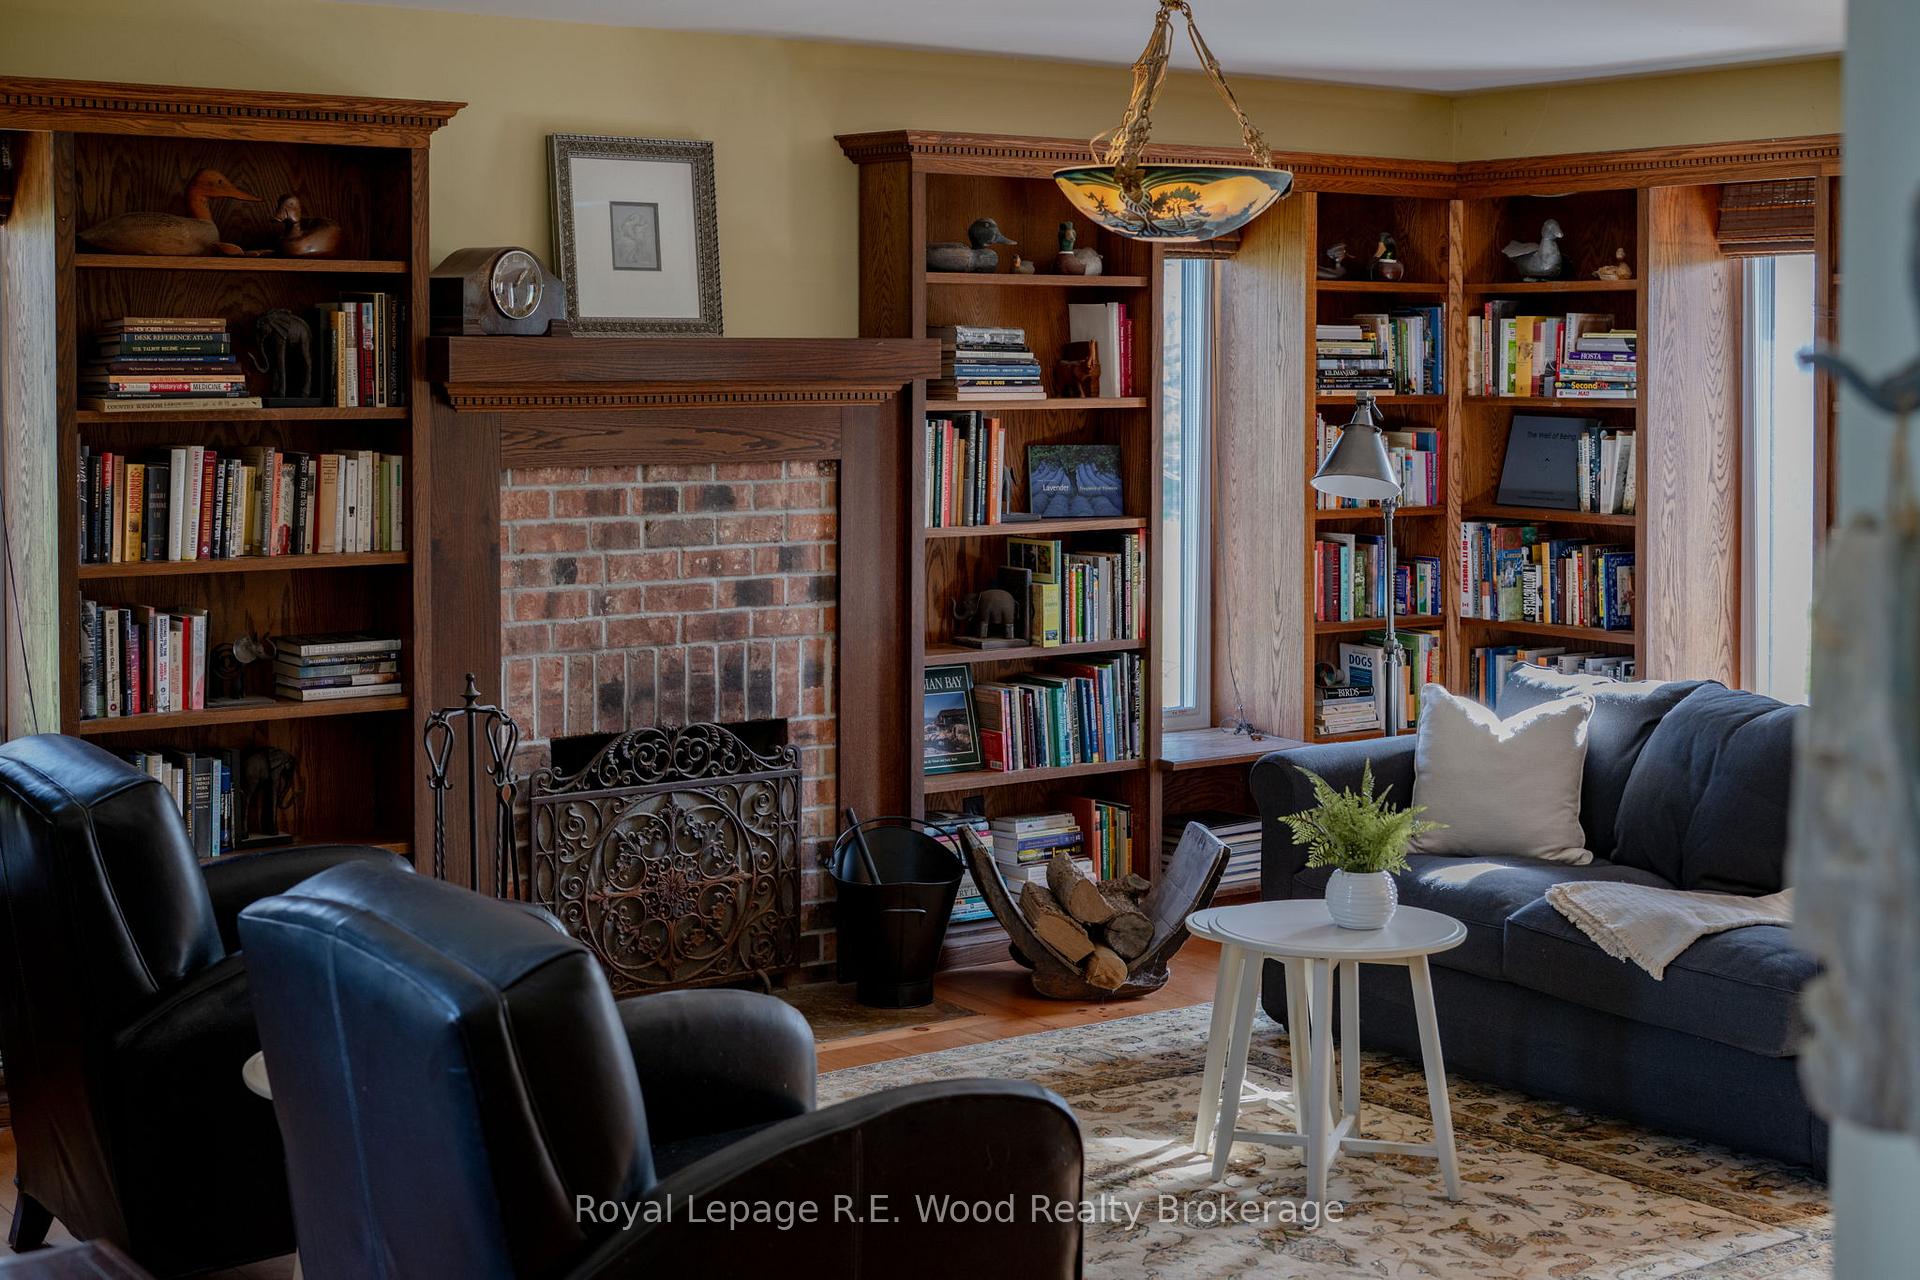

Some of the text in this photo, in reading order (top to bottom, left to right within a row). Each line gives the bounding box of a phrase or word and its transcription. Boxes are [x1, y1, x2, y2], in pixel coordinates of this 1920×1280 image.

[1580, 352, 1602, 360] HOSTA
[1571, 381, 1597, 390] Second
[130, 471, 142, 513] SHANTARAM
[1042, 484, 1069, 492] Lavender
[1522, 571, 1536, 615] MOTORCYCLES
[1349, 654, 1373, 668] DOGS
[944, 676, 963, 688] BAY
[1336, 687, 1360, 697] BIRDS
